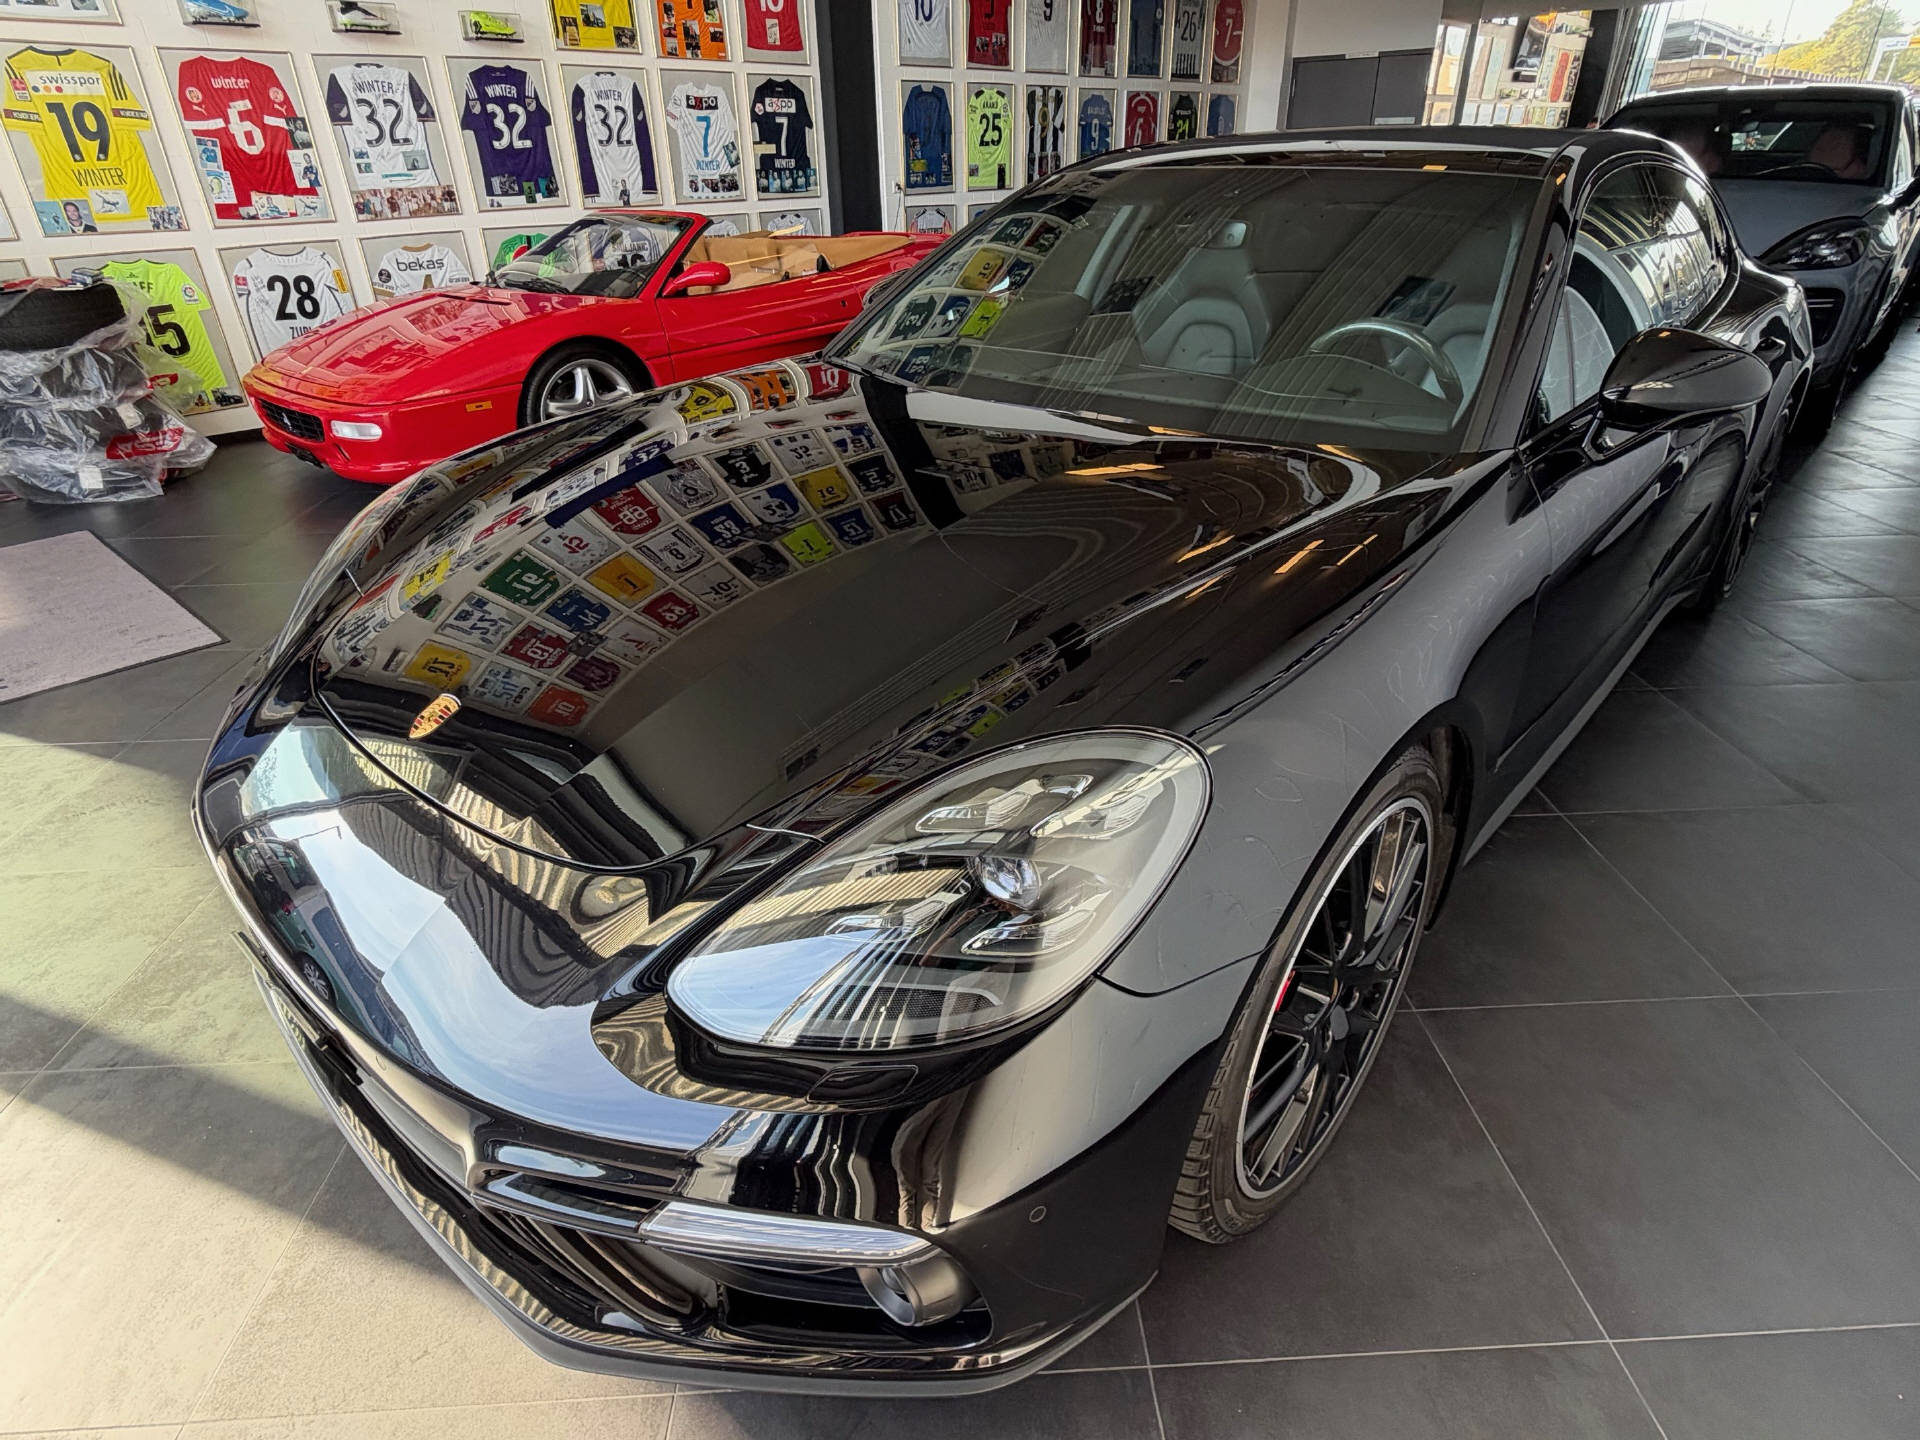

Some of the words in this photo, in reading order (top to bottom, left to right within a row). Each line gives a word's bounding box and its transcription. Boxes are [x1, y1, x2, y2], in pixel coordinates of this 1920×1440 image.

[1180, 10, 1197, 42] 26
[1224, 18, 1233, 49] 7
[210, 76, 249, 89] winter
[354, 79, 395, 95] WINTER
[484, 84, 517, 99] WINTER
[594, 90, 622, 102] WINTER
[45, 101, 110, 163] 19
[227, 99, 265, 155] 6
[355, 98, 414, 147] 32
[485, 103, 533, 150] 32
[594, 104, 634, 147] 32
[696, 115, 711, 158] 7
[775, 116, 789, 157] 7
[979, 112, 1003, 147] 25
[1091, 118, 1100, 151] 9
[71, 167, 128, 187] WINTER
[774, 158, 796, 169] WINTER
[395, 257, 445, 272] bekaş
[266, 274, 321, 321] 28
